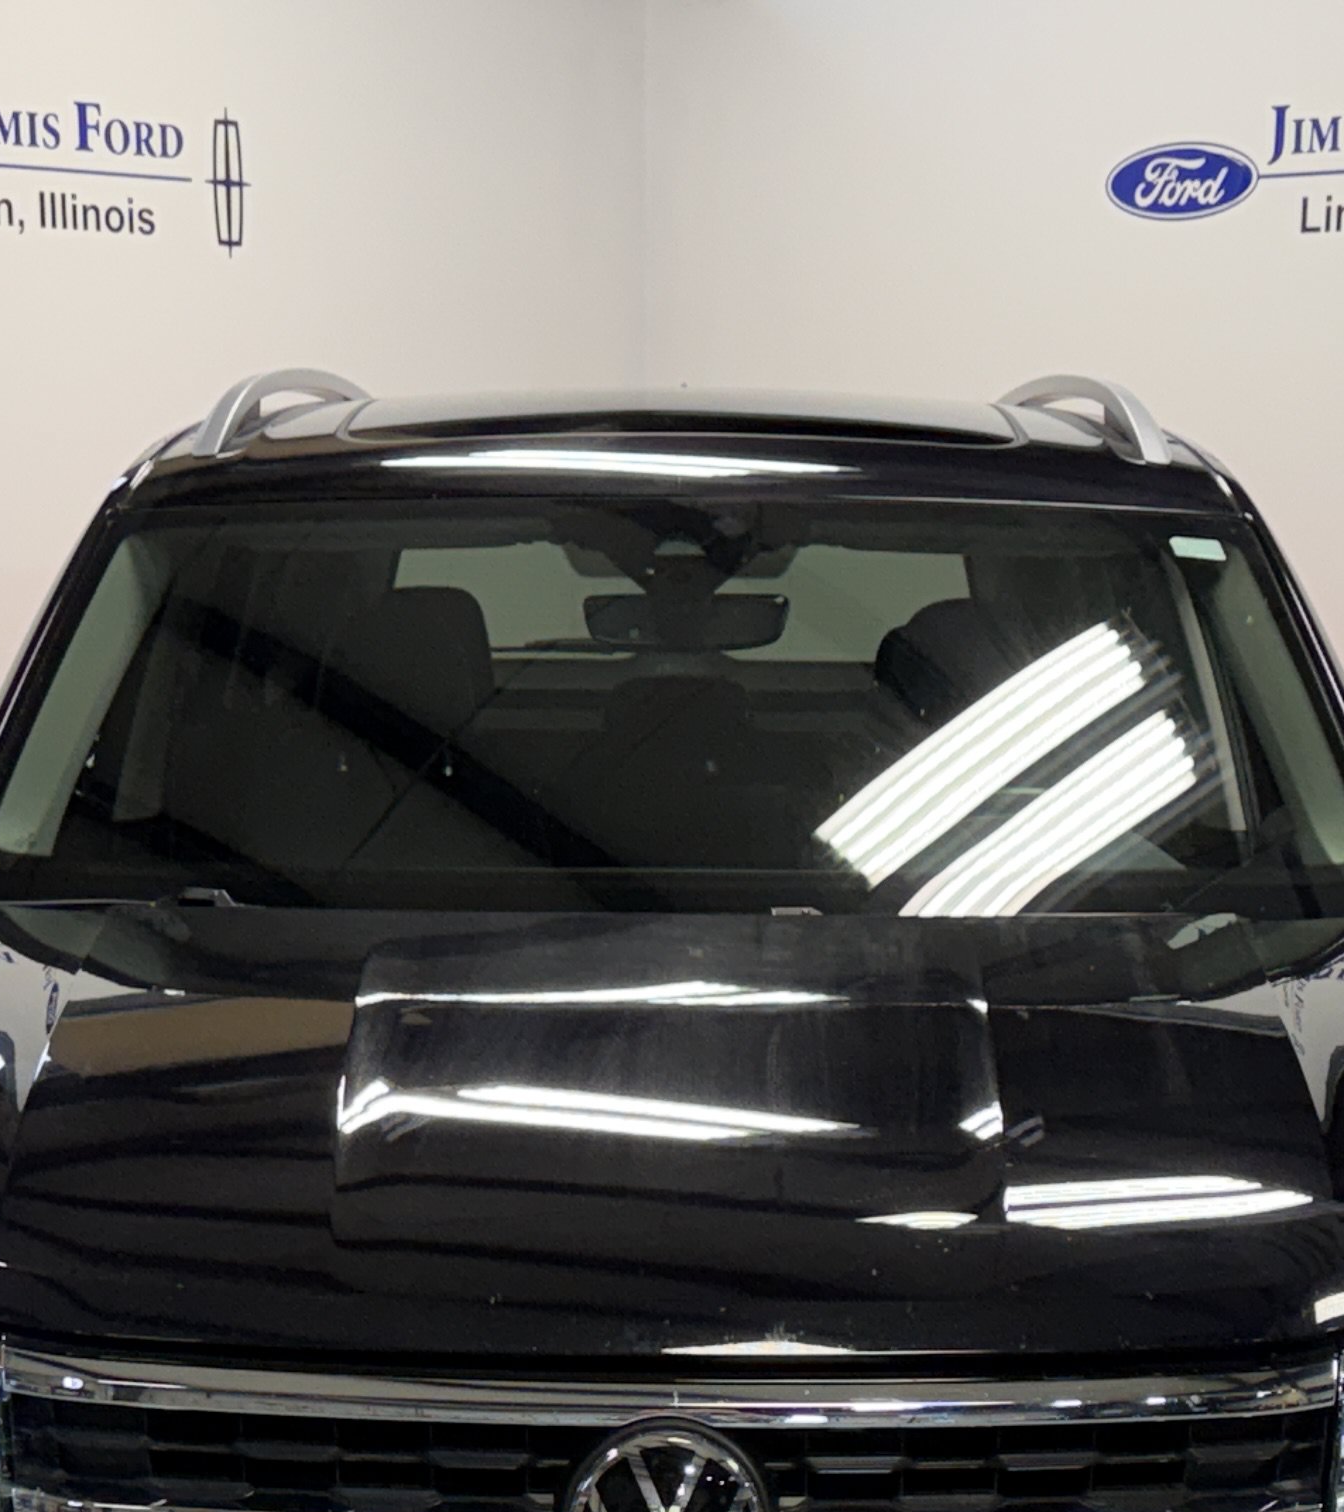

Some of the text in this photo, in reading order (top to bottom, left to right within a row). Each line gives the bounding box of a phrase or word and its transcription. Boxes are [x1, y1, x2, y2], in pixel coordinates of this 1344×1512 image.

[74, 101, 184, 159] FORD
[1268, 105, 1341, 165] JIM
[1134, 157, 1224, 207] Ford
[39, 191, 155, 235] Illinois
